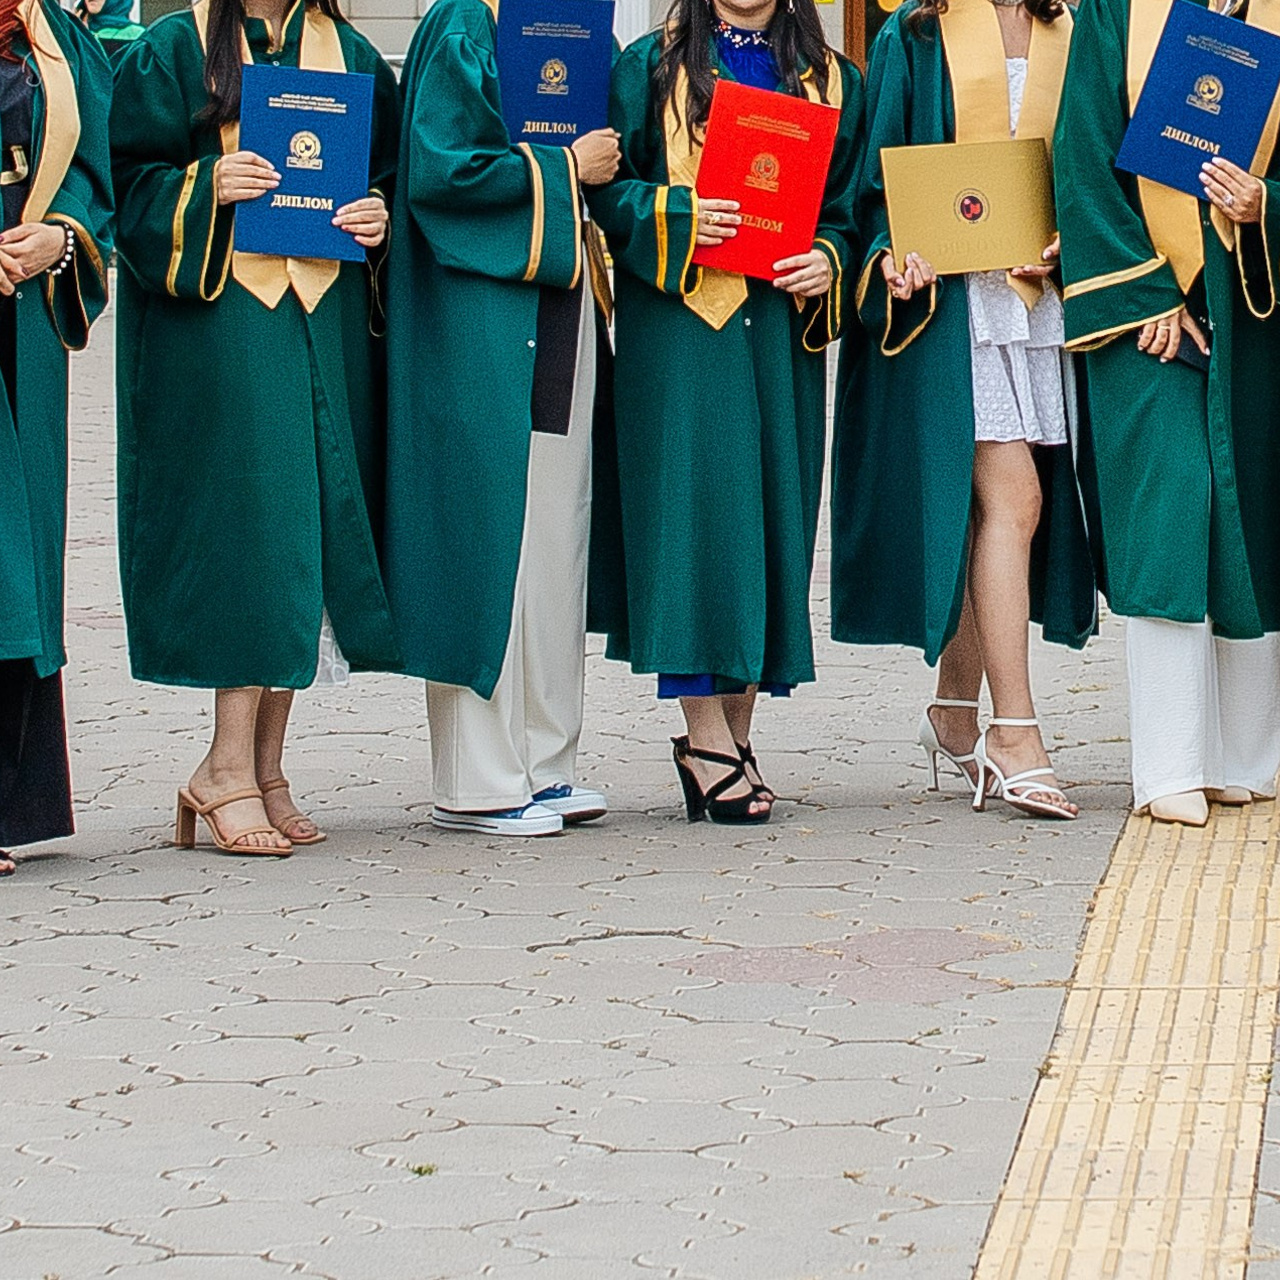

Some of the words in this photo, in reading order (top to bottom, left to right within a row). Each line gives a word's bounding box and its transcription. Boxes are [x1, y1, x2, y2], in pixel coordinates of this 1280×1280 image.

[522, 121, 577, 134] ДИПЛОМ
[1161, 125, 1221, 156] ДИПЛОМ
[271, 194, 333, 210] ДИПЛОМ
